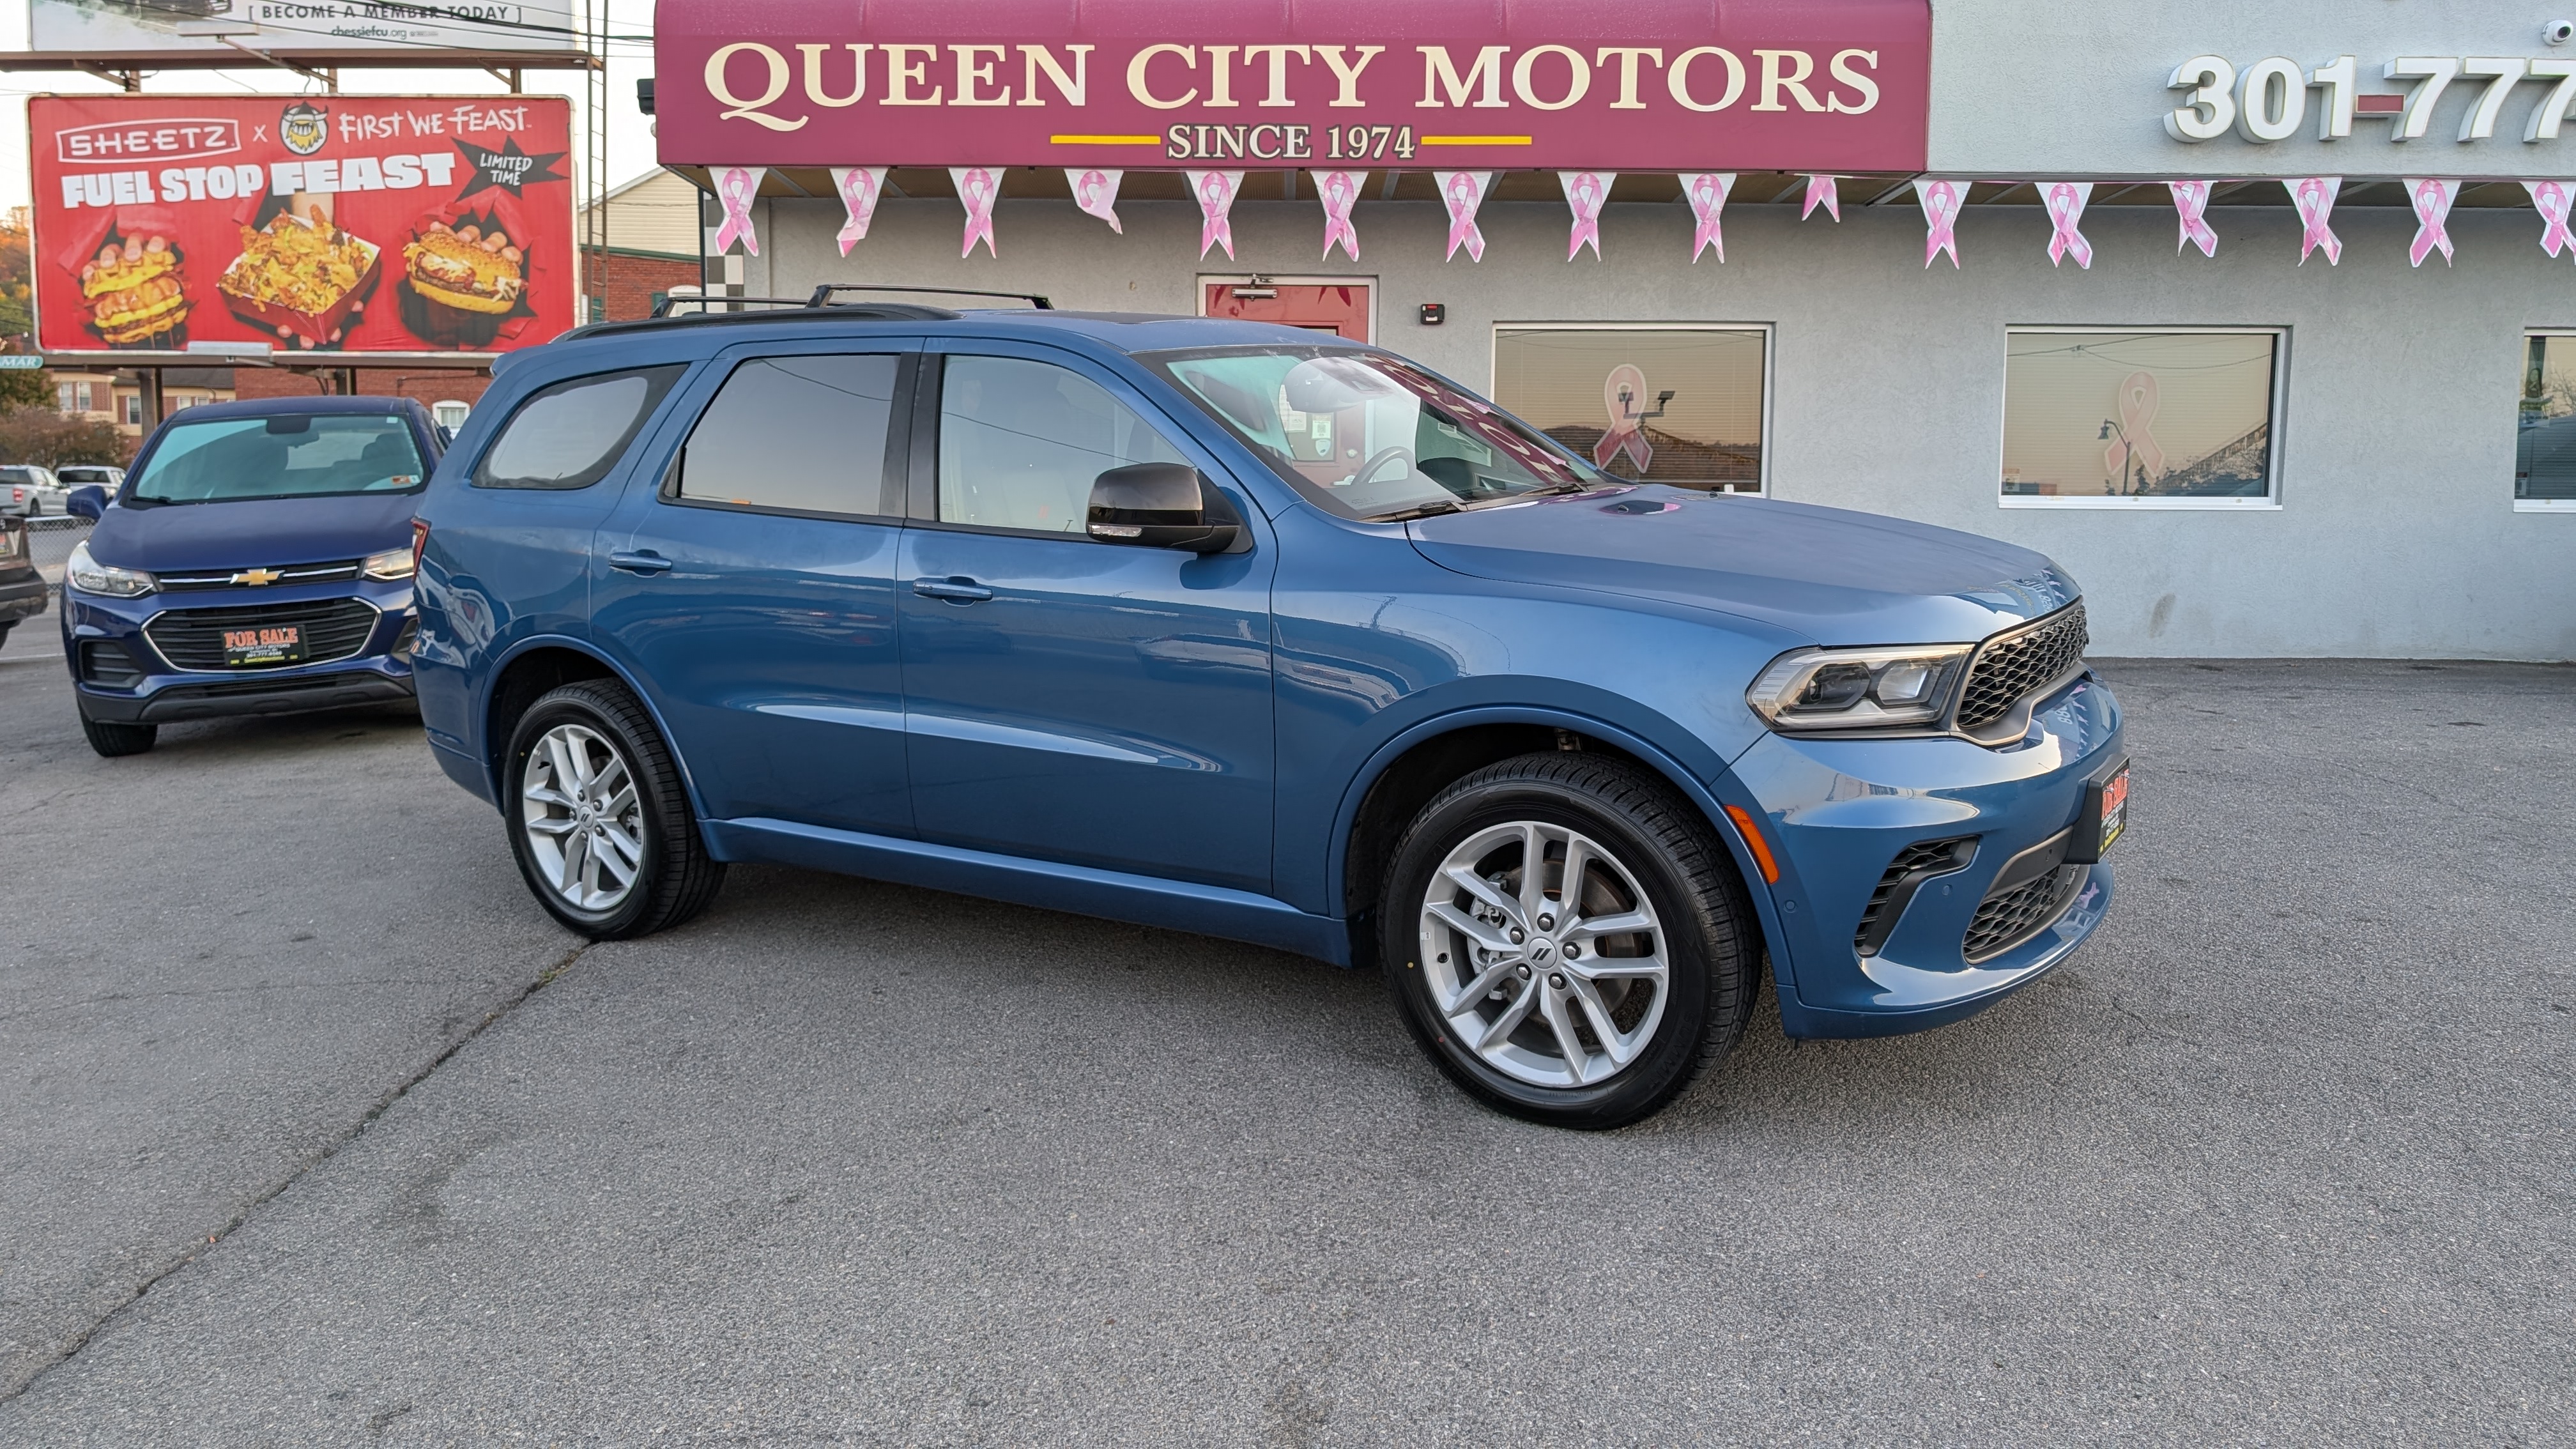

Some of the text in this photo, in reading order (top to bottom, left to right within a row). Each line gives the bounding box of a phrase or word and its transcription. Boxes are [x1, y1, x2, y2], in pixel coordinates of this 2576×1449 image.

[263, 6, 335, 19] BECOME
[344, 6, 355, 18] A
[448, 6, 508, 20] TODAY
[704, 42, 1880, 132] QUEEN CITY MOTORS
[70, 125, 227, 157] SHEETZ
[339, 111, 404, 144] FIRST
[407, 110, 445, 137] WE
[447, 104, 528, 135] FEAST
[1167, 123, 1416, 161] SINCE 1974
[479, 153, 533, 172] LIMITED
[61, 152, 456, 210] FUEL STOP FEAST
[489, 169, 521, 186] TIME
[224, 627, 298, 648] FOR SALE
